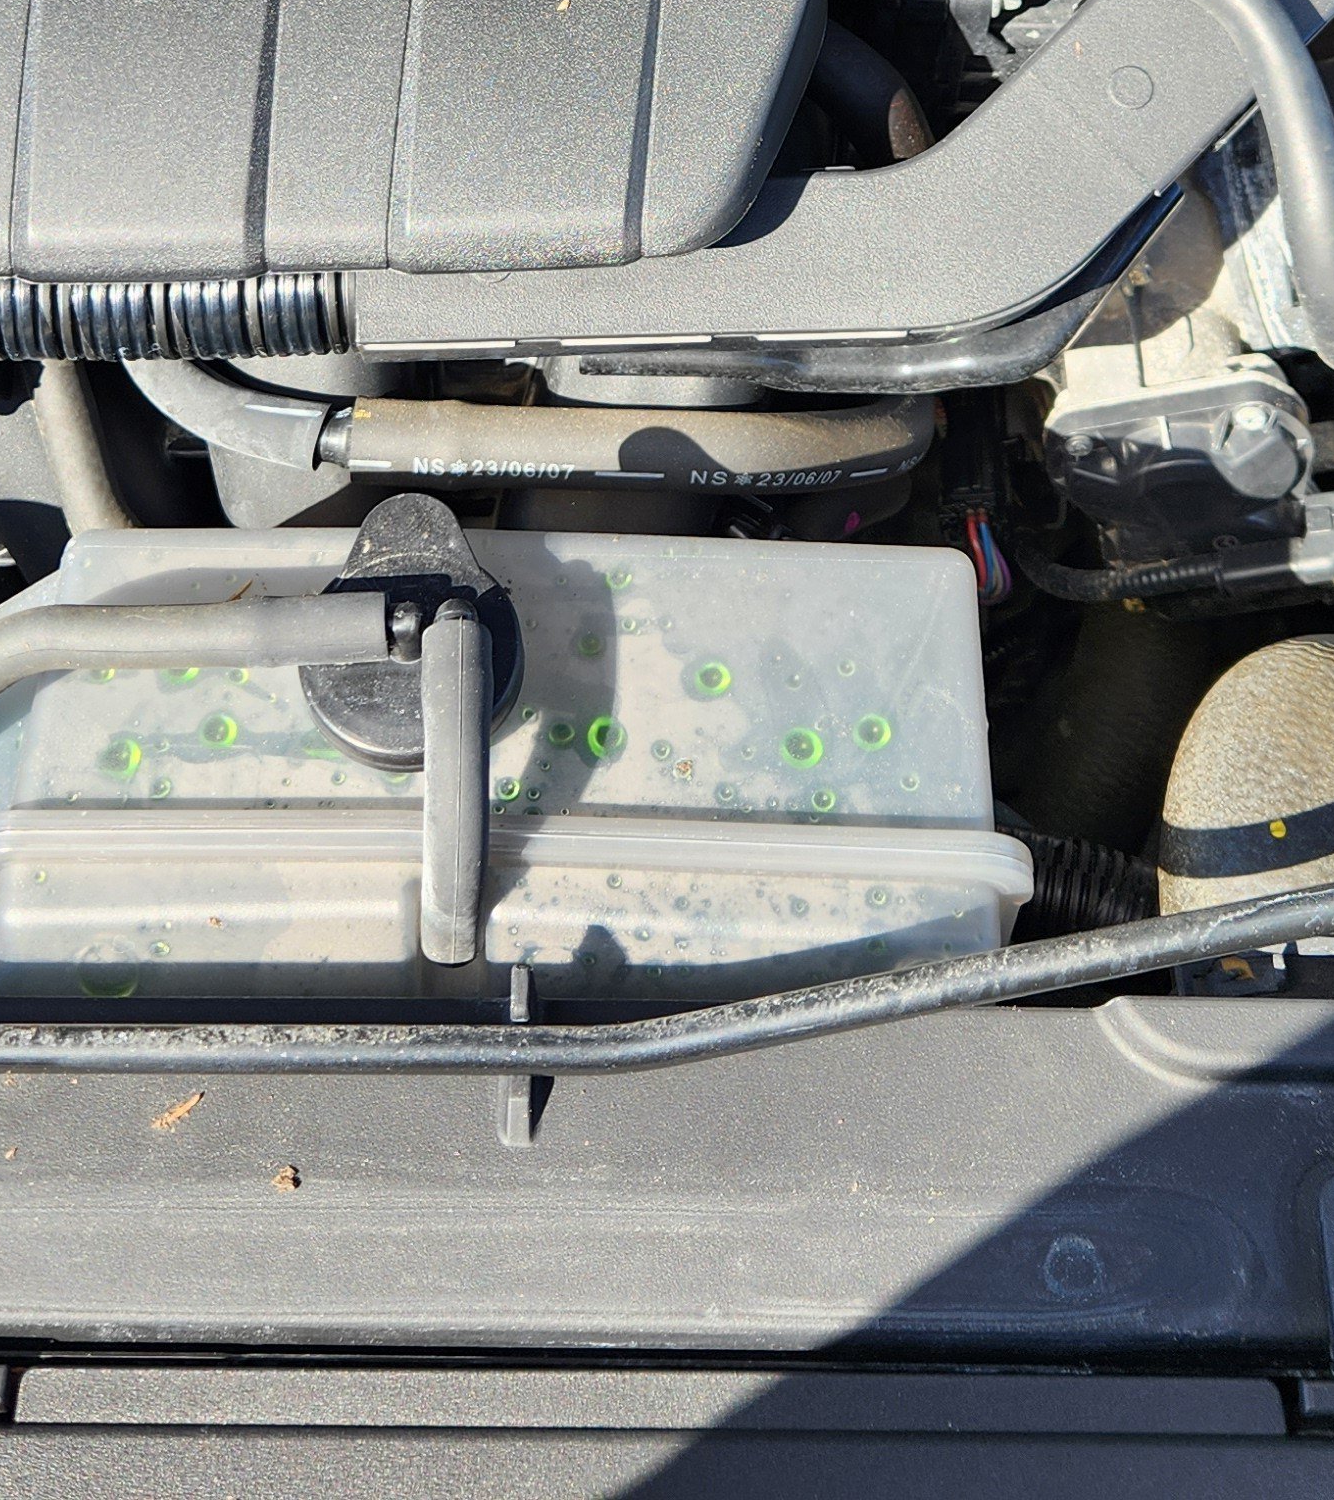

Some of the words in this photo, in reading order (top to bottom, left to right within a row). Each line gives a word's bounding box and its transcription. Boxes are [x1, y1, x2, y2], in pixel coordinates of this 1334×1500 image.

[413, 456, 446, 476] NS
[471, 459, 576, 481] 23/06/07
[689, 469, 727, 486] NS
[756, 469, 843, 487] 23/06/07
